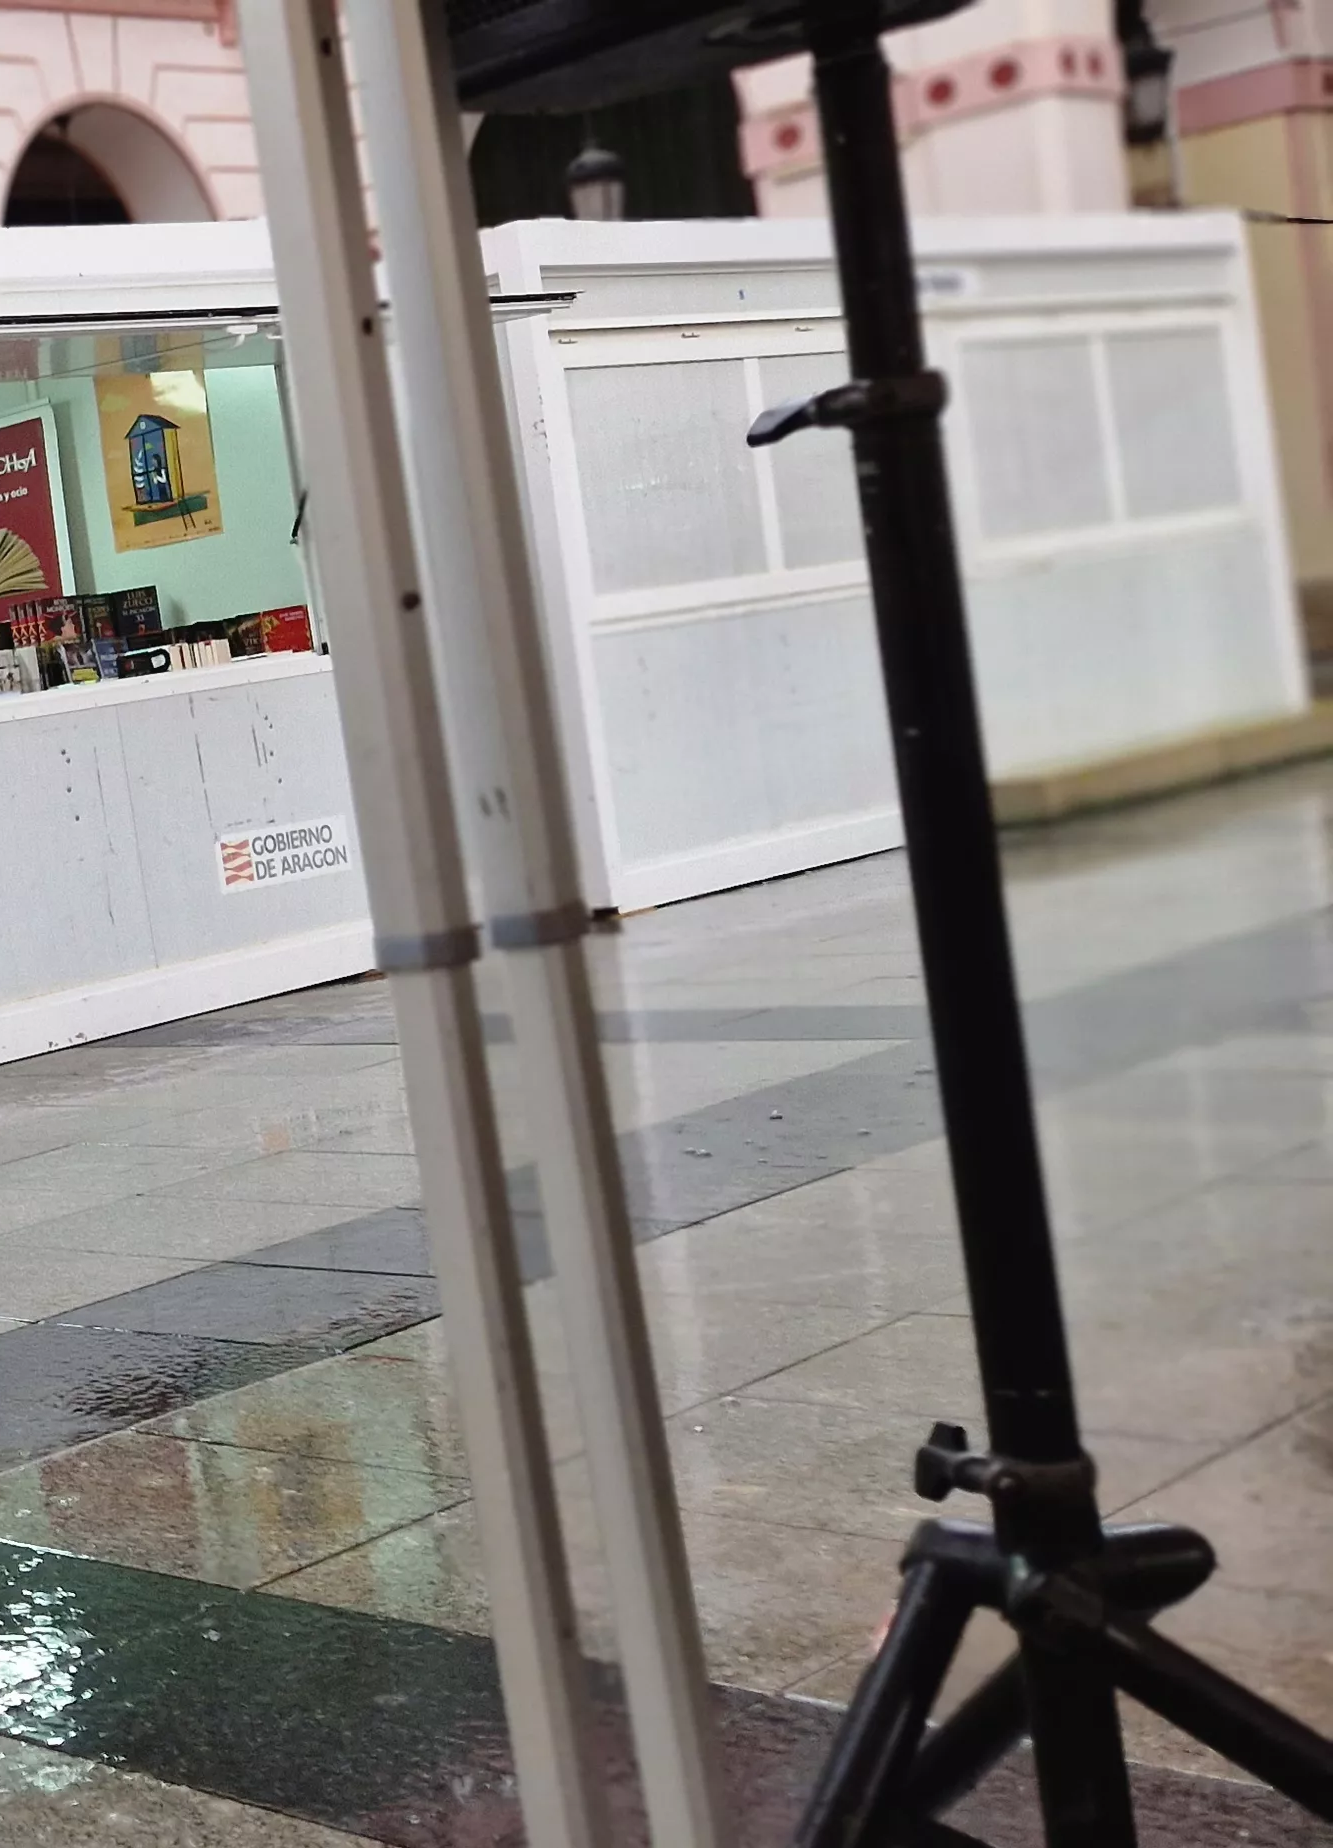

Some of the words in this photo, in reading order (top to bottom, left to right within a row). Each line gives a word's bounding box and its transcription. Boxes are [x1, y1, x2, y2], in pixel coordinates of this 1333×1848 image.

[4, 493, 10, 503] y
[11, 486, 28, 499] ocio
[252, 824, 332, 856] GOBIERNO
[255, 858, 277, 880] DE
[282, 845, 348, 876] ARAGON
